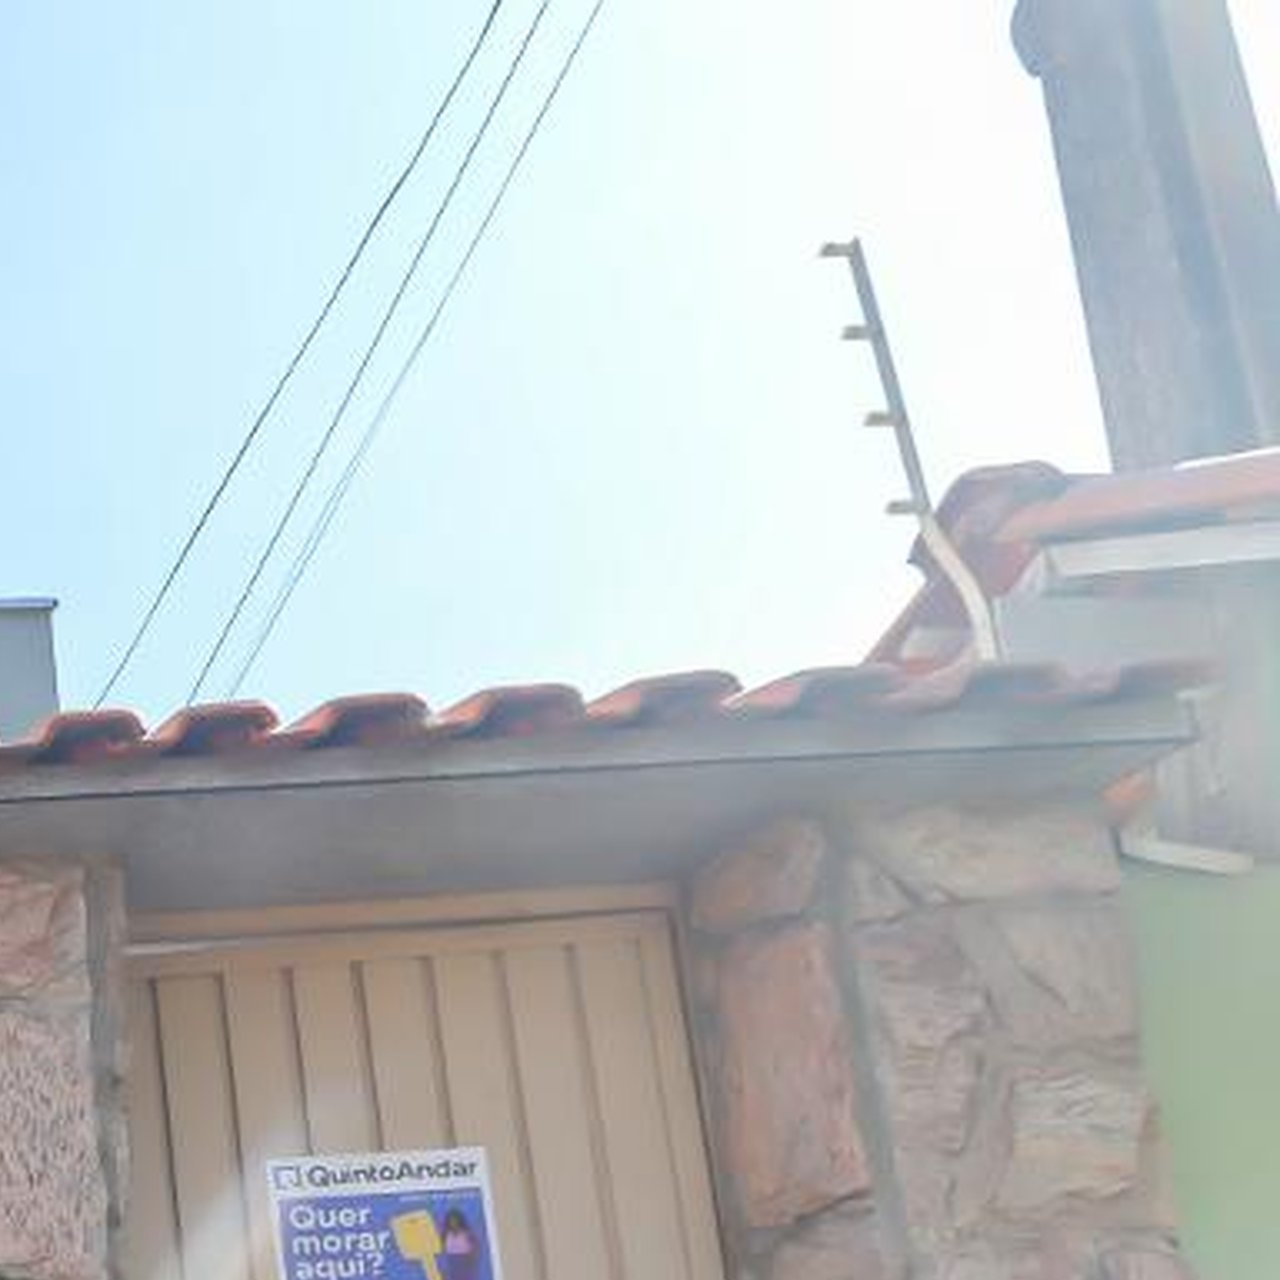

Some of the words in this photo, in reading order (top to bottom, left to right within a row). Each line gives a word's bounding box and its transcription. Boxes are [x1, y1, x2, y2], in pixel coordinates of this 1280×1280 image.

[307, 1160, 477, 1188] QuintoAndar
[289, 1206, 372, 1230] Quer
[292, 1231, 390, 1255] morar
